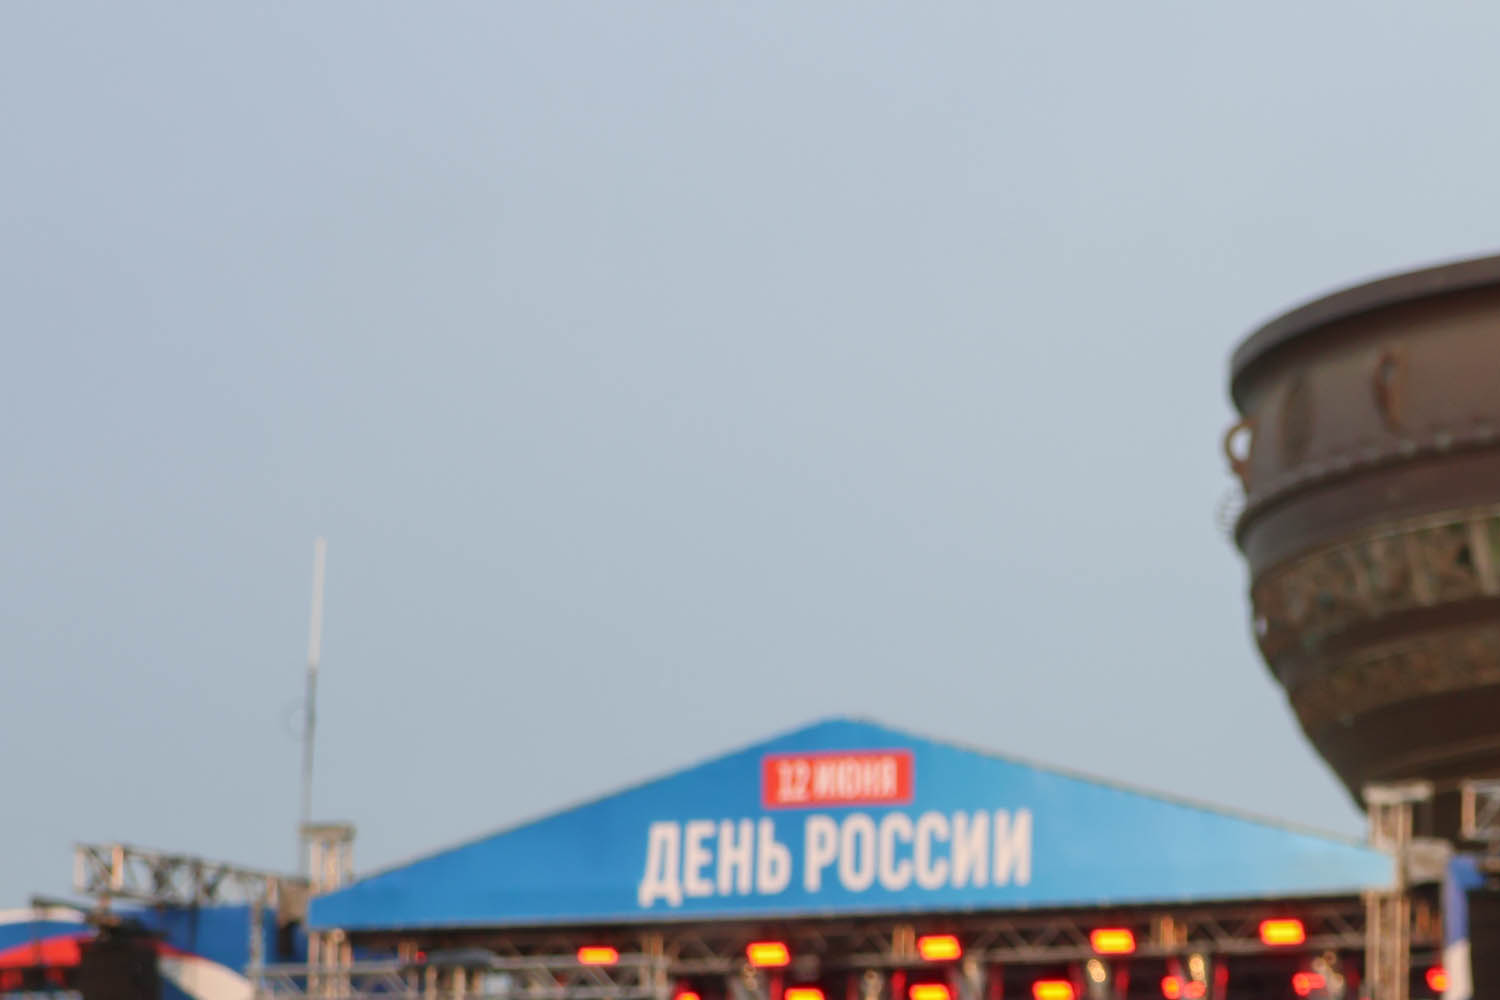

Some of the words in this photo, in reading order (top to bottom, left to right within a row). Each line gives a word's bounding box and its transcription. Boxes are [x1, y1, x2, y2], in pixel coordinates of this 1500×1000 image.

[778, 760, 811, 802] 12
[813, 757, 897, 799] ИЮНЯ
[638, 816, 791, 908] ДЕНЬ
[804, 809, 1032, 892] РОССИИ
